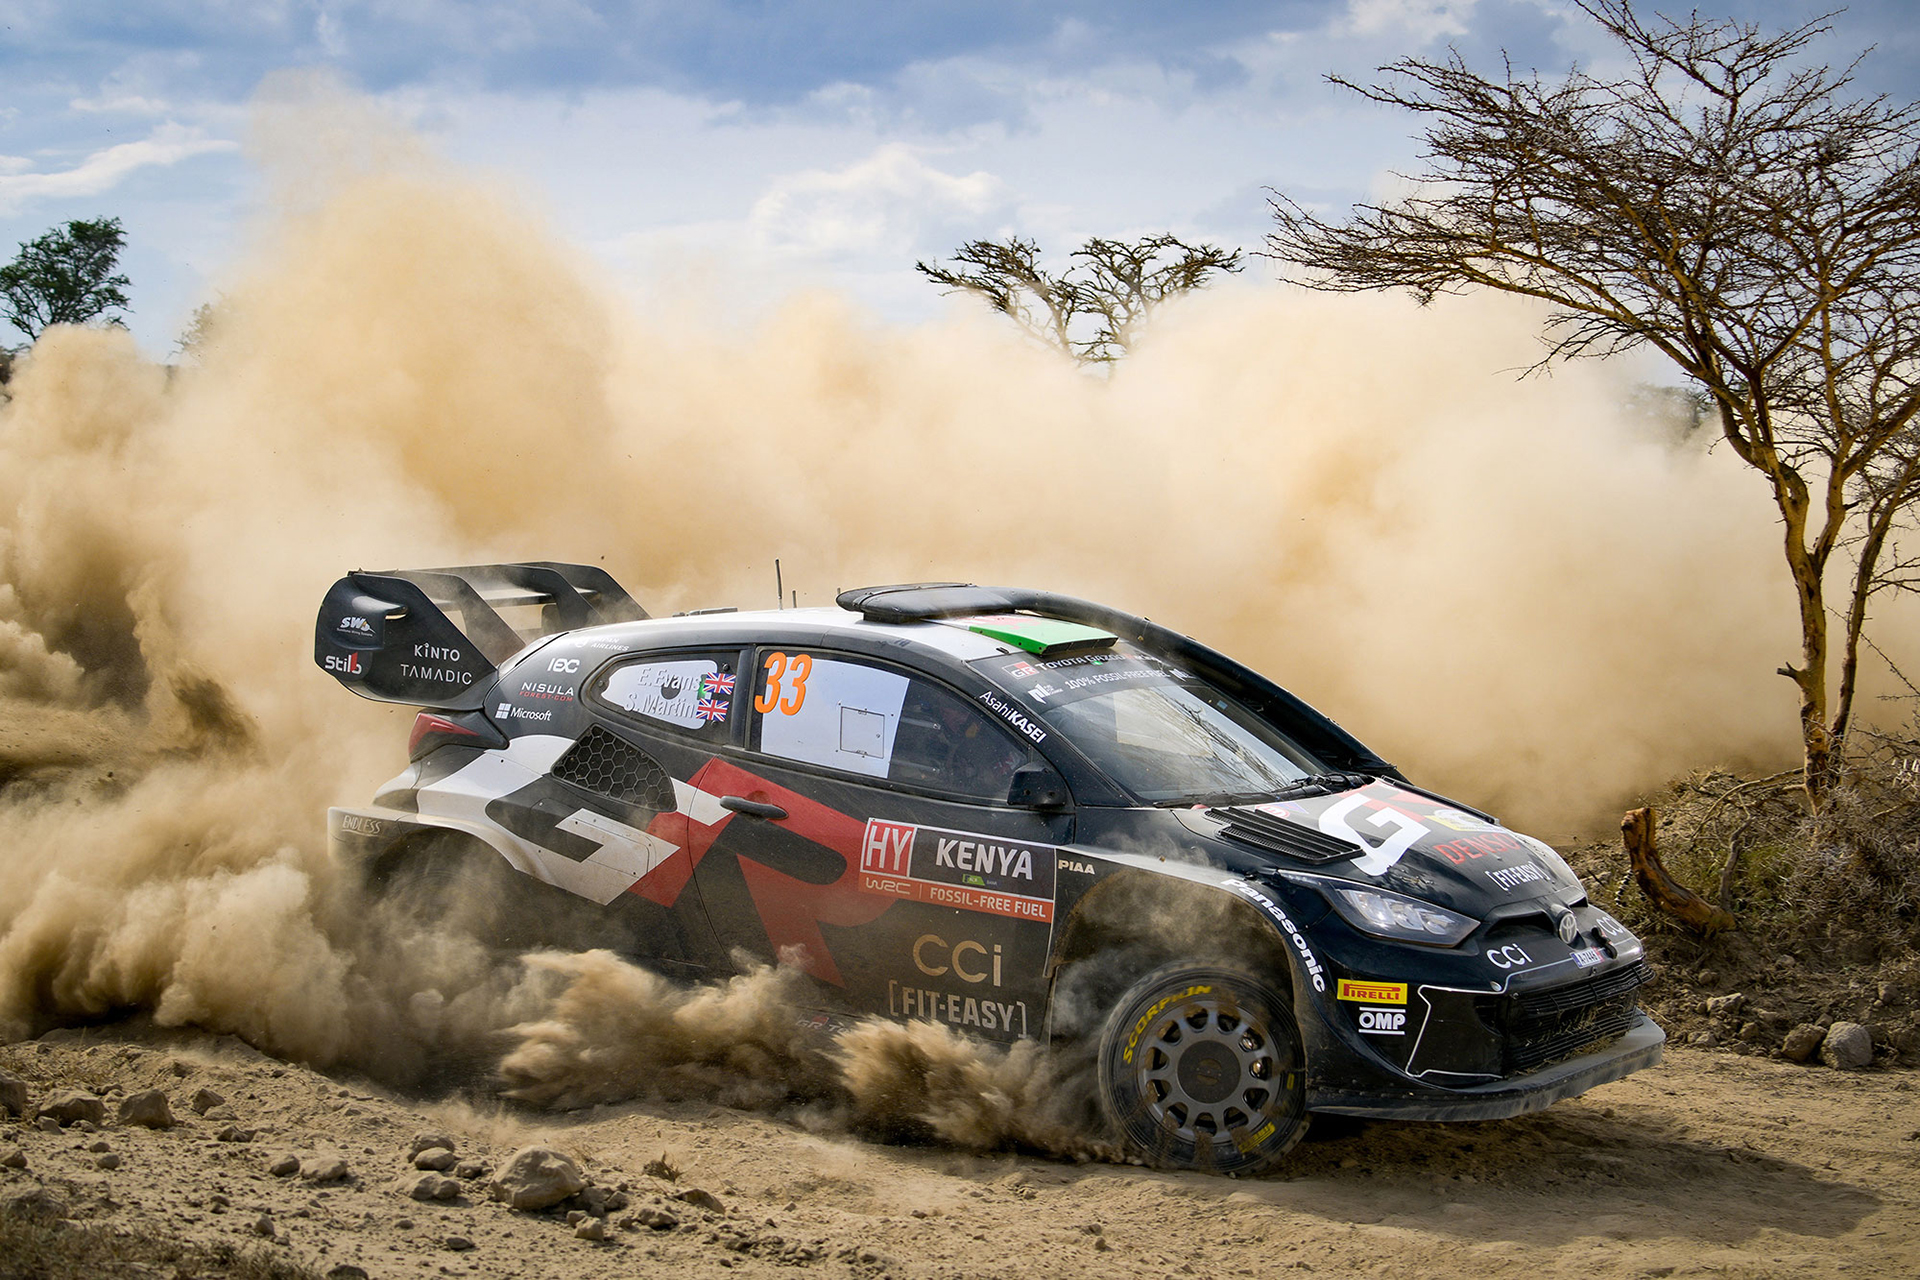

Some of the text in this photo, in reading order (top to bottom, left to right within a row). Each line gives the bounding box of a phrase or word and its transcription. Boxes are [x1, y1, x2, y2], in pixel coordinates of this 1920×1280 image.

[590, 643, 630, 651] AIRLINES
[400, 663, 472, 685] TAMADIC
[1064, 675, 1097, 690] 100%
[521, 682, 574, 696] NISULA
[754, 652, 813, 716] 33
[511, 707, 552, 721] Microsoft
[342, 815, 382, 834] ENDLESS
[866, 824, 1034, 881] HY KENYA
[1432, 832, 1521, 865] DENSO
[1058, 859, 1096, 876] PIAA
[866, 877, 1047, 918] WRC FOSSIL-FREE FUEL
[1220, 878, 1326, 992] Panasonic
[1343, 983, 1402, 1000] PIRELLI
[1358, 1011, 1406, 1030] OMP
